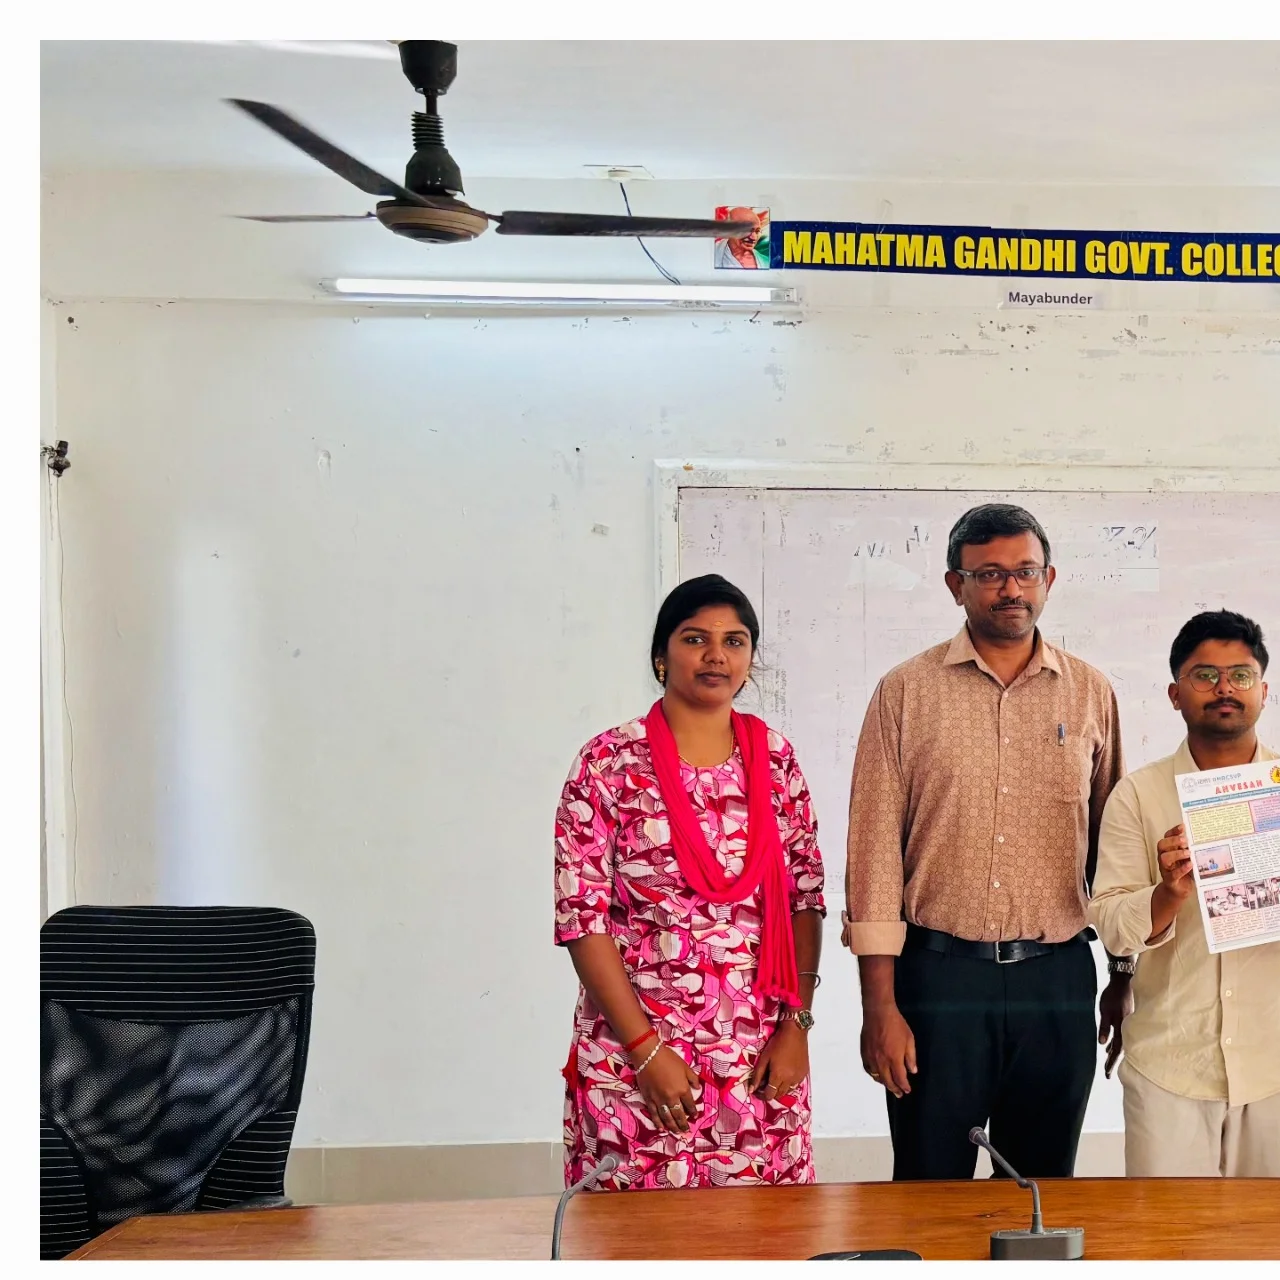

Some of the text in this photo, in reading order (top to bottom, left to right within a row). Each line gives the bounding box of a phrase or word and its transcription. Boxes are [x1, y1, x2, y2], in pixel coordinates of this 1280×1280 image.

[782, 230, 946, 269] MAHATMA
[954, 235, 1076, 273] GANDHI
[1084, 238, 1175, 276] GOVT.
[1008, 291, 1093, 306] Mayabunder
